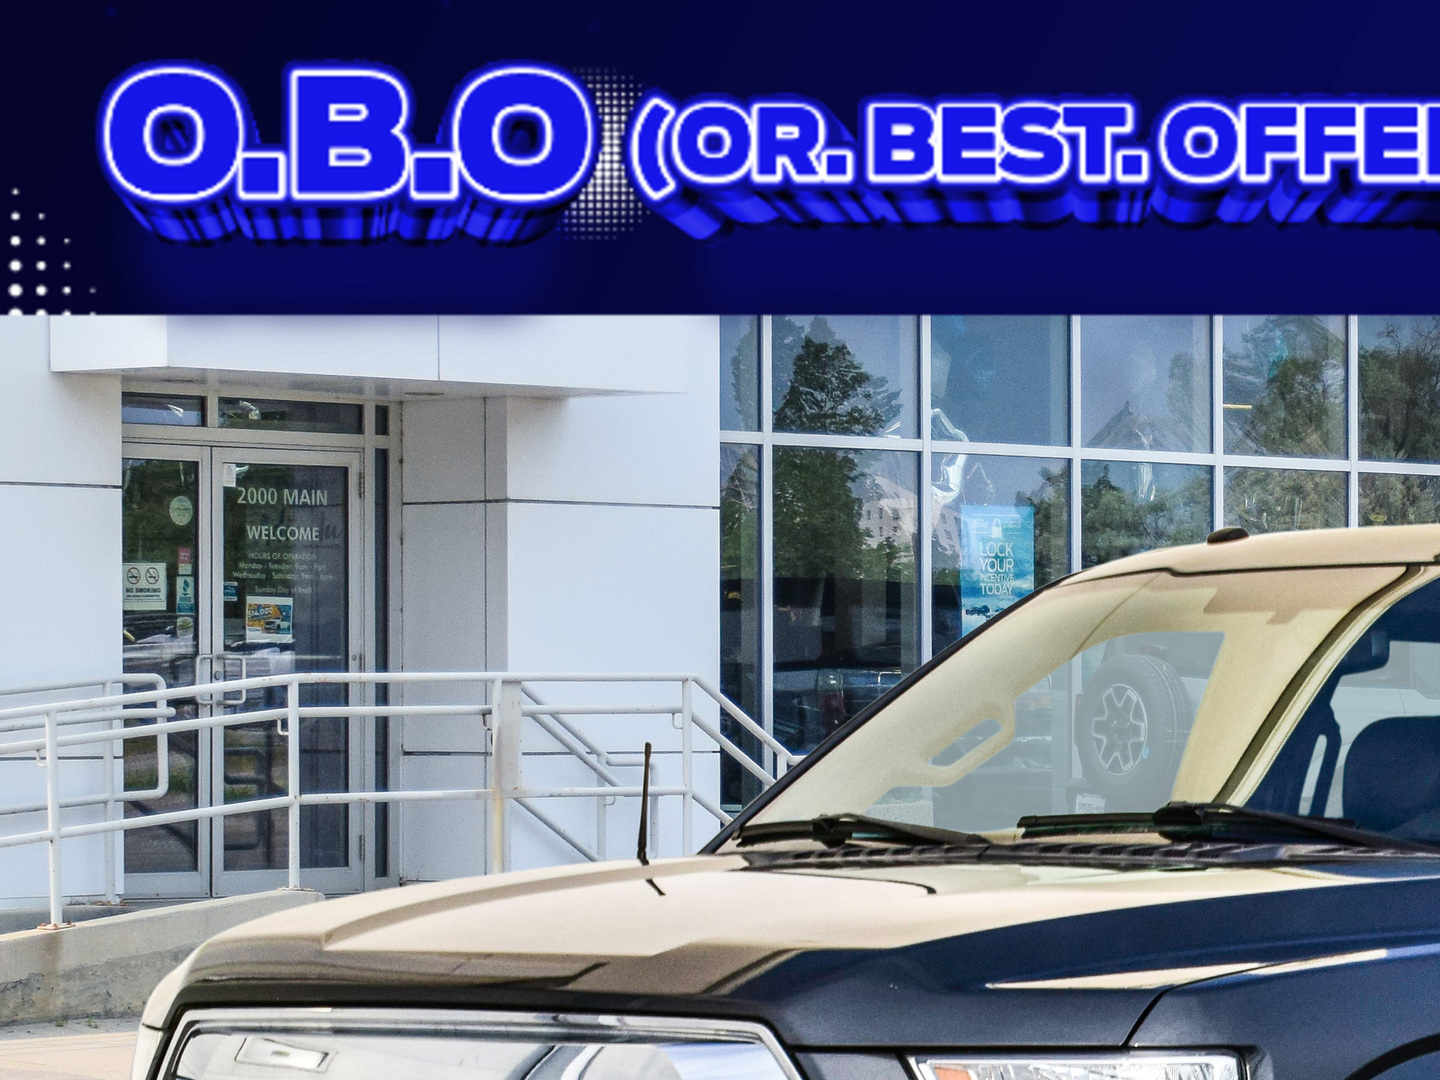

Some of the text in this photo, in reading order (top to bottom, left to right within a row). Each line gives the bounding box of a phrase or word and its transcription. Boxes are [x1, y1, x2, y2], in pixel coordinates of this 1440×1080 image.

[237, 487, 328, 506] 2000 MAIN
[246, 525, 320, 541] WELCOME
[248, 552, 270, 560] HOURS
[271, 552, 280, 560] OF
[980, 541, 1014, 557] LOCK
[980, 558, 1015, 573] YOUR
[979, 573, 1015, 582] NCENTIVE
[980, 583, 1013, 595] TODAY
